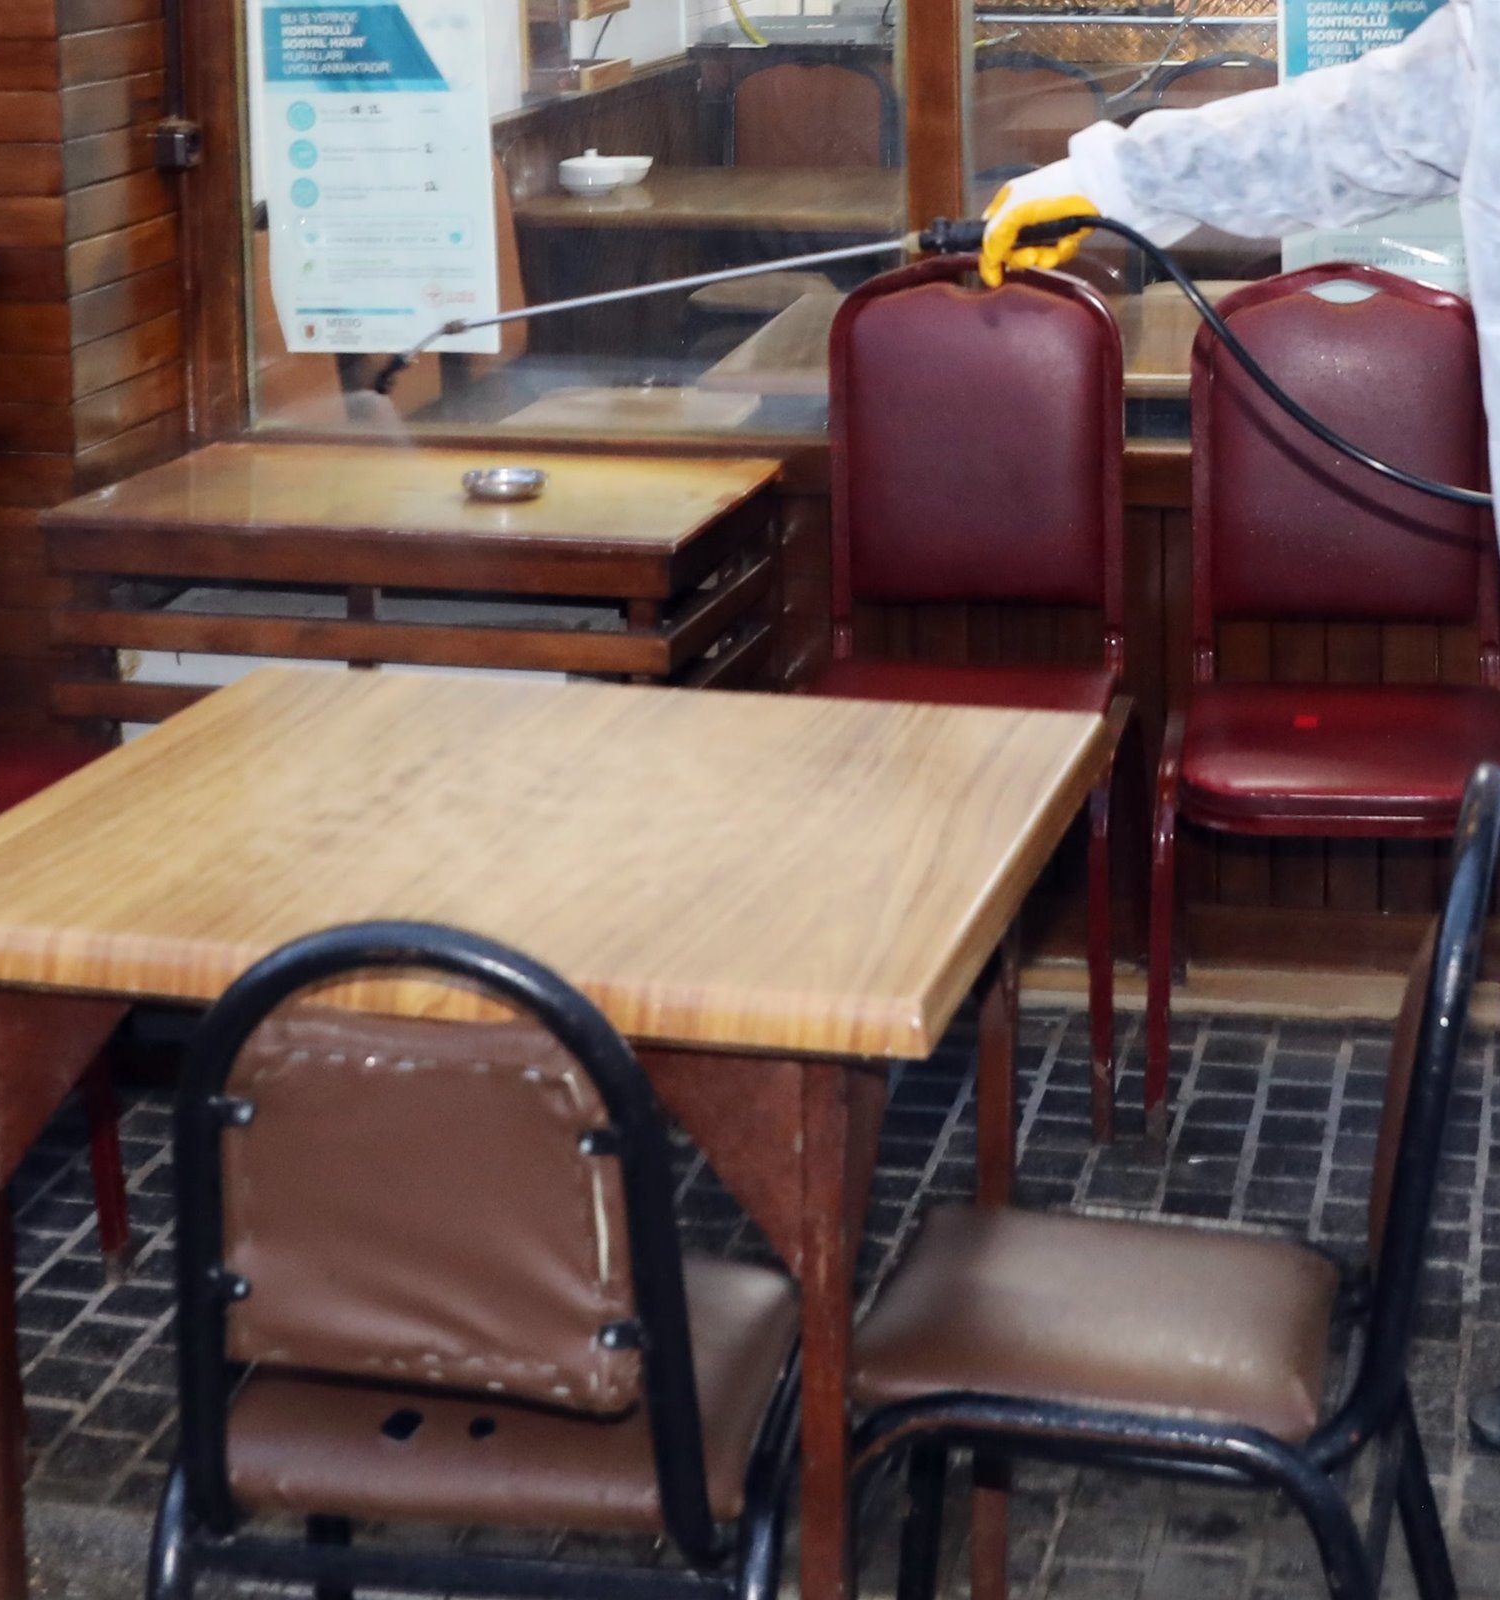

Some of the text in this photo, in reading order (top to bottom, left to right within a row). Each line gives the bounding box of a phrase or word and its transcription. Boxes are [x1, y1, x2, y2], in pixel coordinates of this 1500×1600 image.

[1307, 15, 1388, 27] KONTROLLÜ
[281, 24, 353, 36] KONTROLLÜ
[1307, 29, 1405, 41] SOSYAL HAYAT
[282, 36, 367, 49] SOSYAL HAYAT
